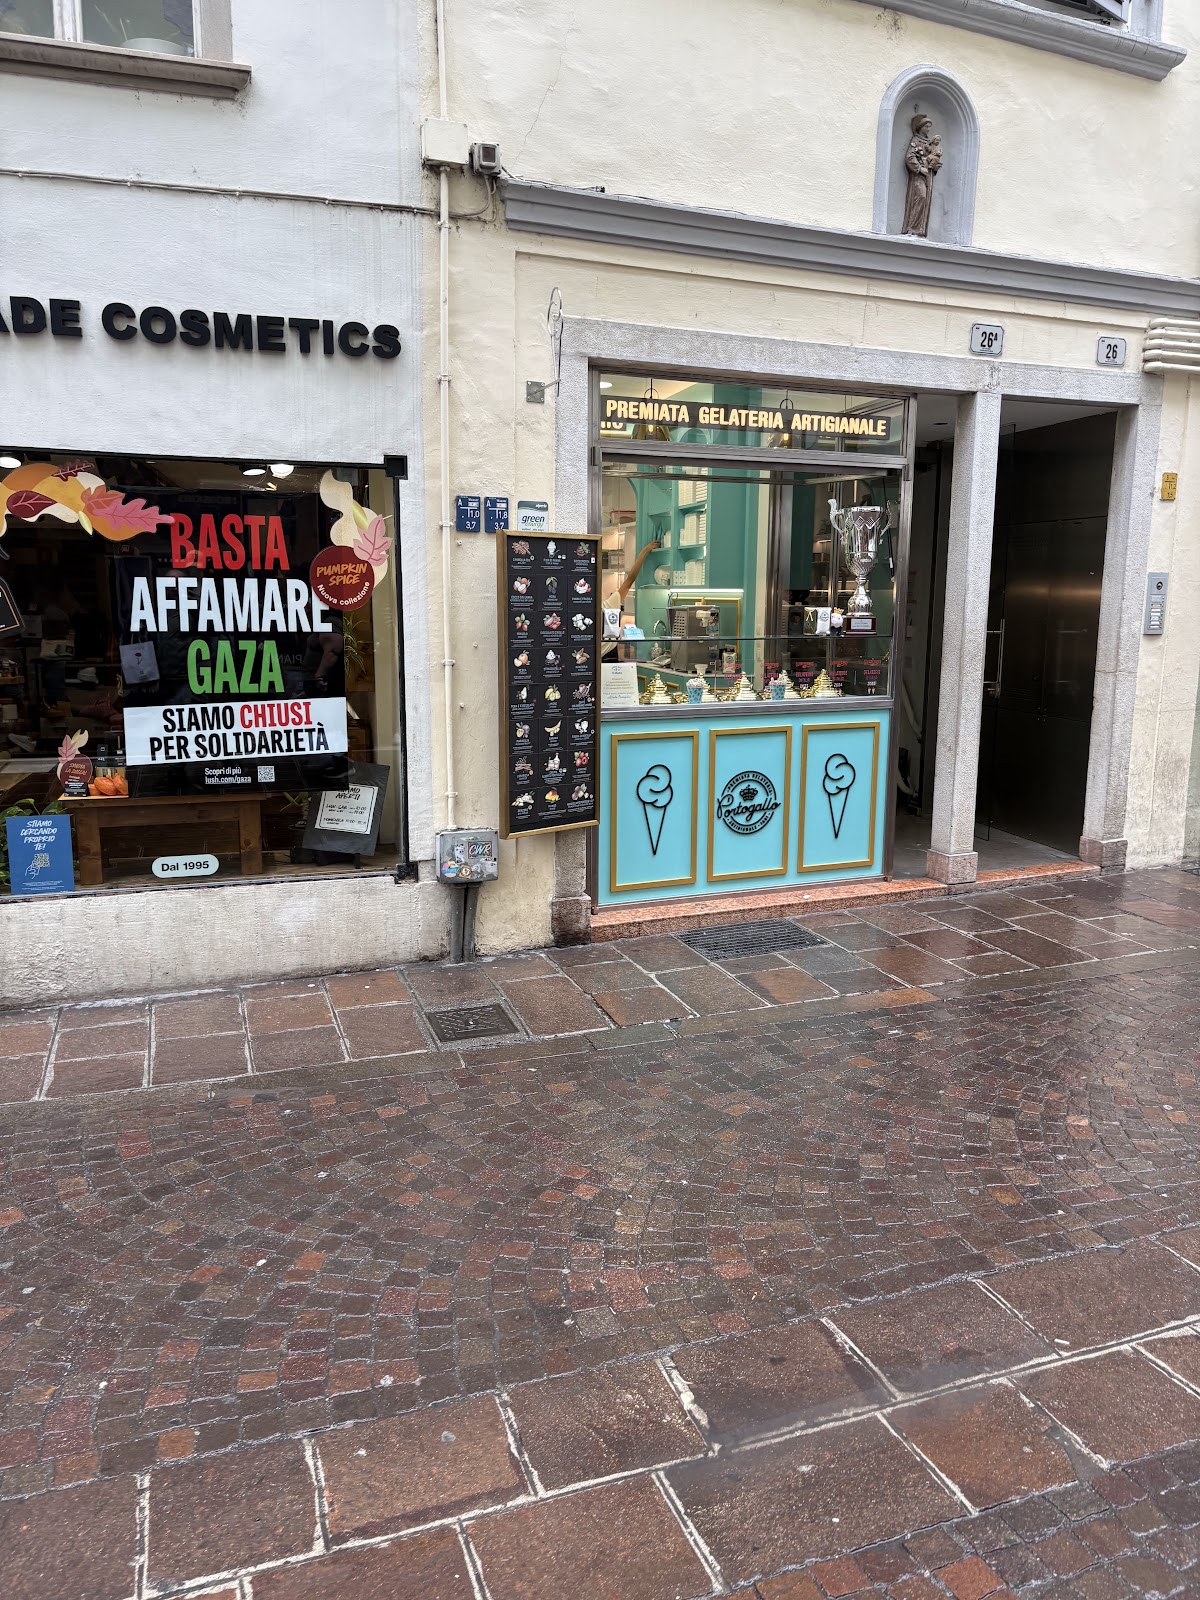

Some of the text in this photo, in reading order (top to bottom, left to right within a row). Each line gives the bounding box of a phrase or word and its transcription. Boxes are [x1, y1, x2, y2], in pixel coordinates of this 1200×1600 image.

[0, 296, 402, 360] DE COSMETICS
[1105, 343, 1118, 359] 26
[606, 399, 887, 437] PREMIATA GELATERIA ARTIGIANALE
[465, 521, 476, 530] 3,7
[521, 514, 545, 524] green
[170, 513, 290, 571] BASTA
[316, 563, 368, 578] PUMPKIN
[328, 574, 361, 586] SPICE
[317, 581, 370, 606] Nuova collezione
[130, 576, 333, 632] AFFAMARE
[187, 639, 285, 694] GAZA
[162, 701, 312, 733] SIAMO CHIUSI
[150, 722, 330, 761] PER SOLIDARIETÀ
[204, 767, 242, 776] Scopri di più
[204, 775, 252, 785] lush.com/gaza
[717, 794, 781, 821] Portogallo
[20, 827, 58, 836] CERCANDO
[23, 836, 56, 844] PROPRIO
[34, 843, 46, 851] TE!
[161, 860, 210, 872] Dal 1995
